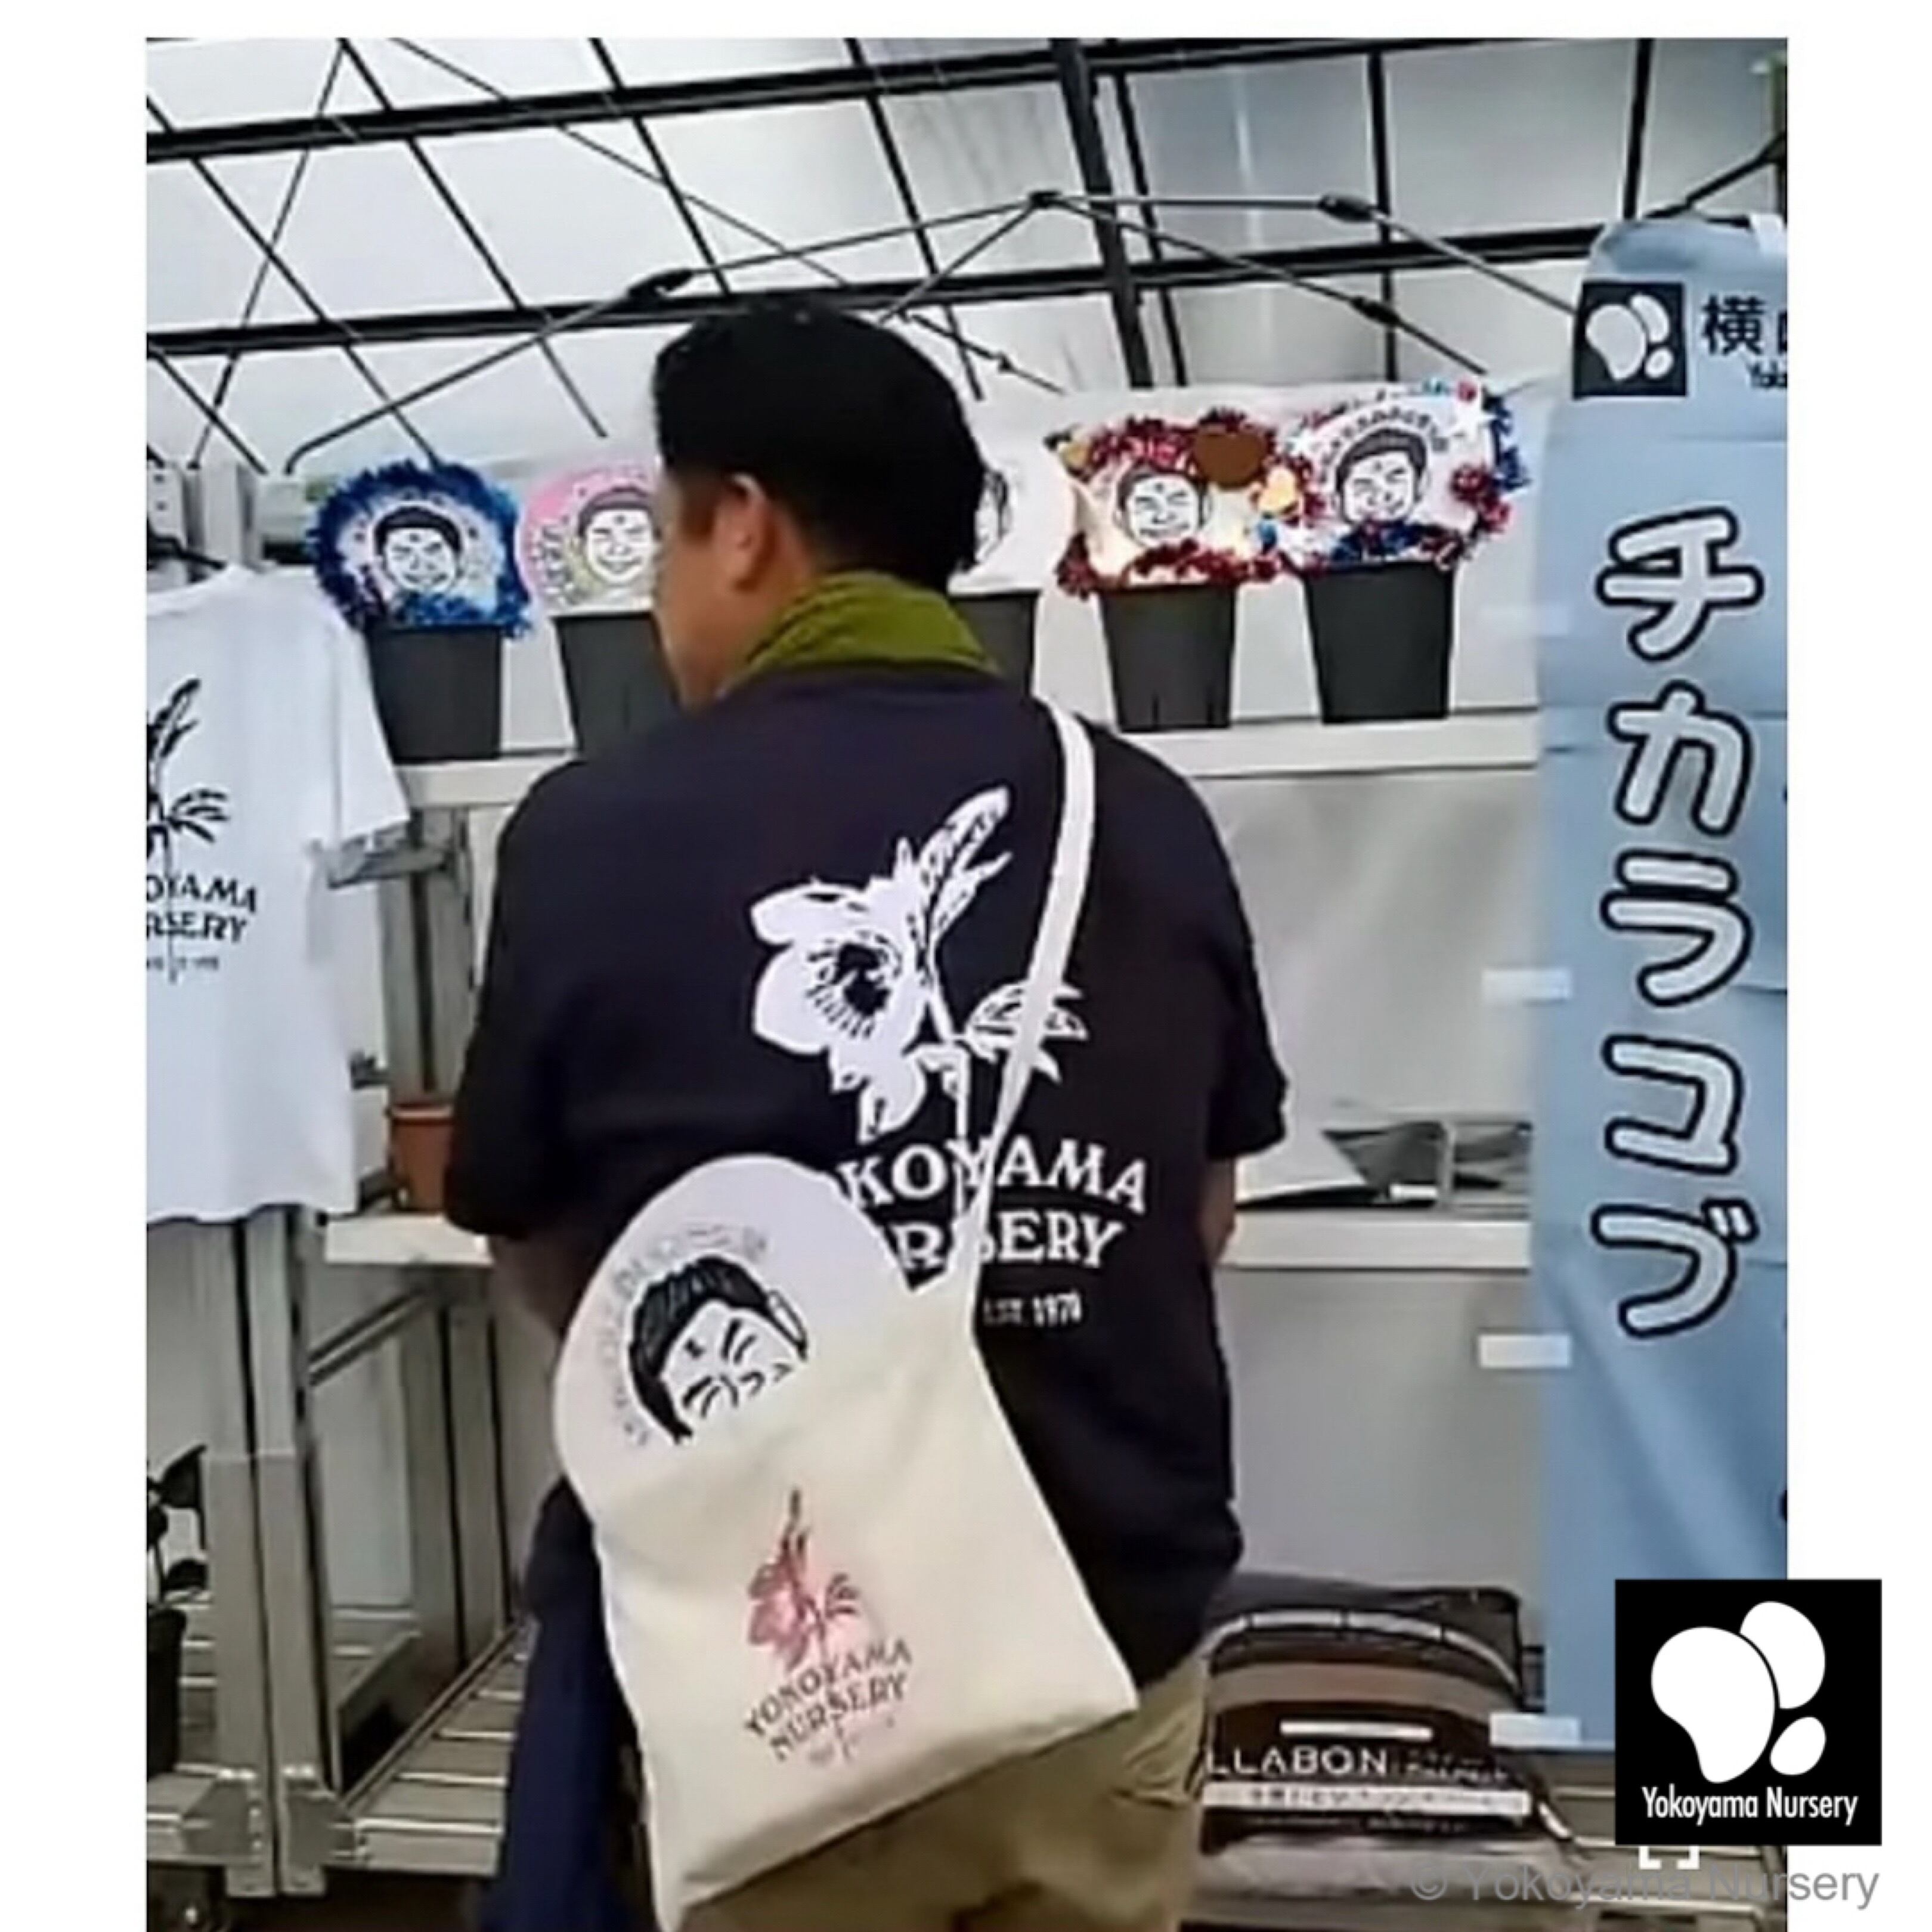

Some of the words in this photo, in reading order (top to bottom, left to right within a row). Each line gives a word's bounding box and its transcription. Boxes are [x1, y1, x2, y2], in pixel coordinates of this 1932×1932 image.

[1701, 295, 1787, 357] 横
[1594, 506, 1765, 1339] チカラコブ
